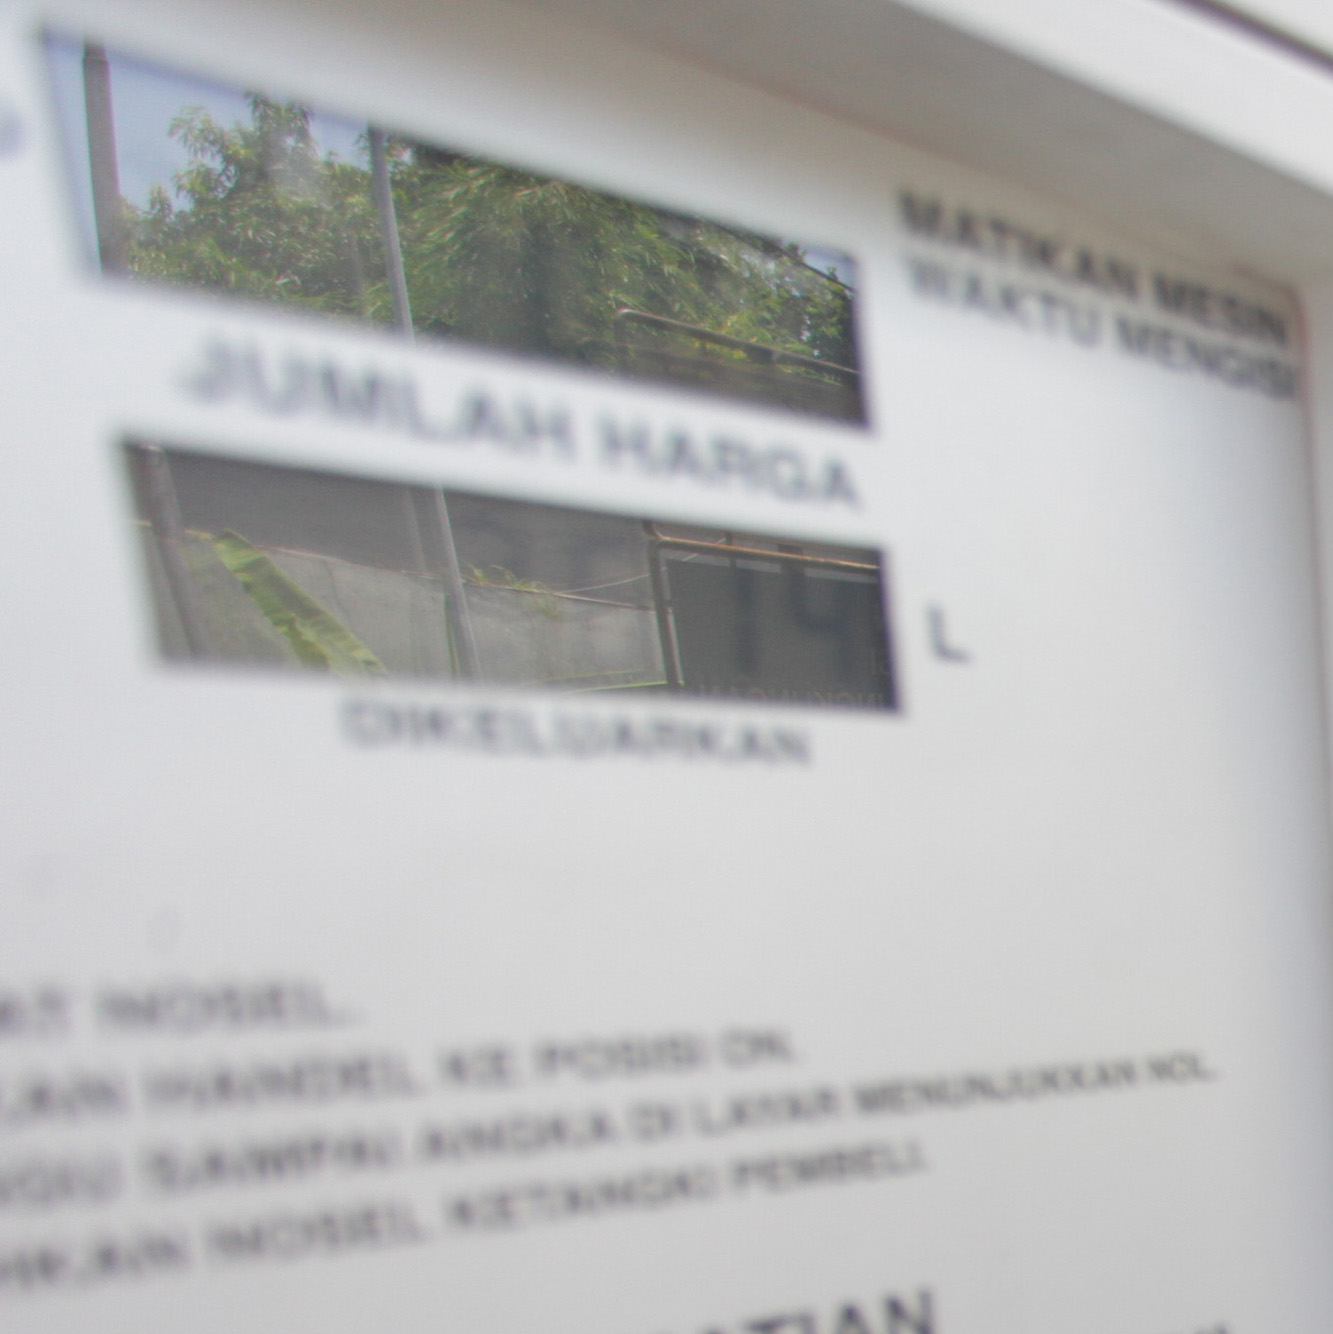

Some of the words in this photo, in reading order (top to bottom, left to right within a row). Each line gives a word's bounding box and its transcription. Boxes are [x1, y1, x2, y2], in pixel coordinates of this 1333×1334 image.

[911, 257, 1100, 348] WAKTU
[186, 334, 577, 462] JUMLAH
[598, 412, 862, 512] HARGA
[927, 605, 970, 663] L
[340, 697, 812, 764] DIKELUARKAN
[440, 1043, 520, 1090] KE
[420, 1105, 618, 1165] ANGKA
[693, 1087, 840, 1136] LAYAR
